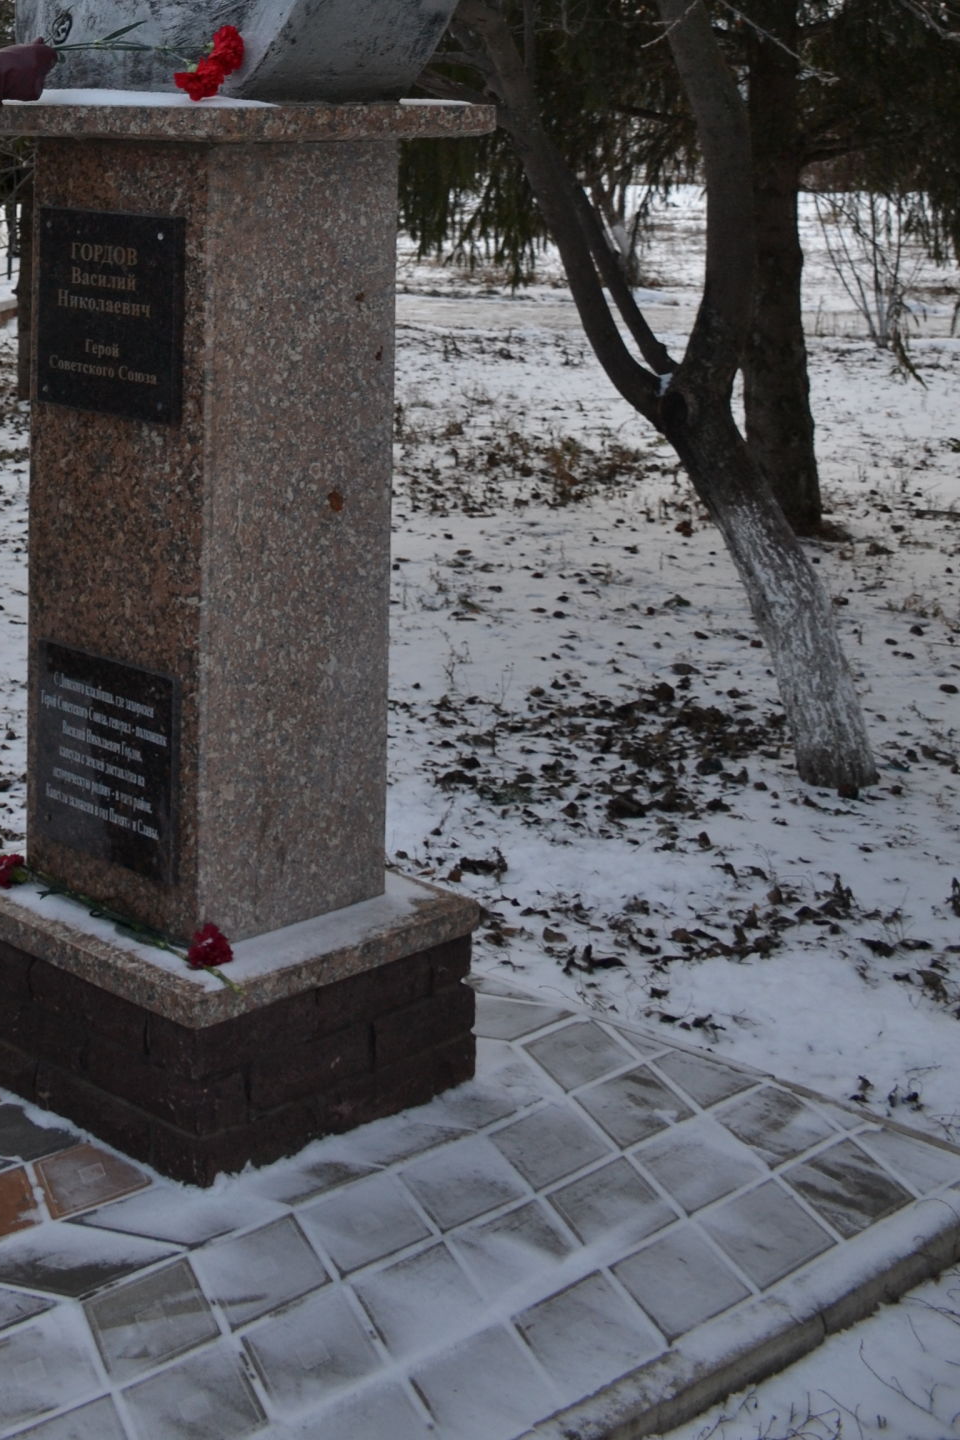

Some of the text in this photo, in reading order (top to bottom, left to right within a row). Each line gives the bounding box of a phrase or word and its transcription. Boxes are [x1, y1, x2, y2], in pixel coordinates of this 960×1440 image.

[71, 242, 138, 266] ГОРДОВ
[71, 267, 137, 292] Василий
[58, 290, 151, 319] Николаевич
[86, 338, 119, 359] Герой
[49, 355, 157, 385] Советского Союза
[40, 688, 56, 708] Герой
[57, 694, 87, 719] Советского
[62, 719, 85, 741] Василий
[86, 727, 120, 754] Николаевич
